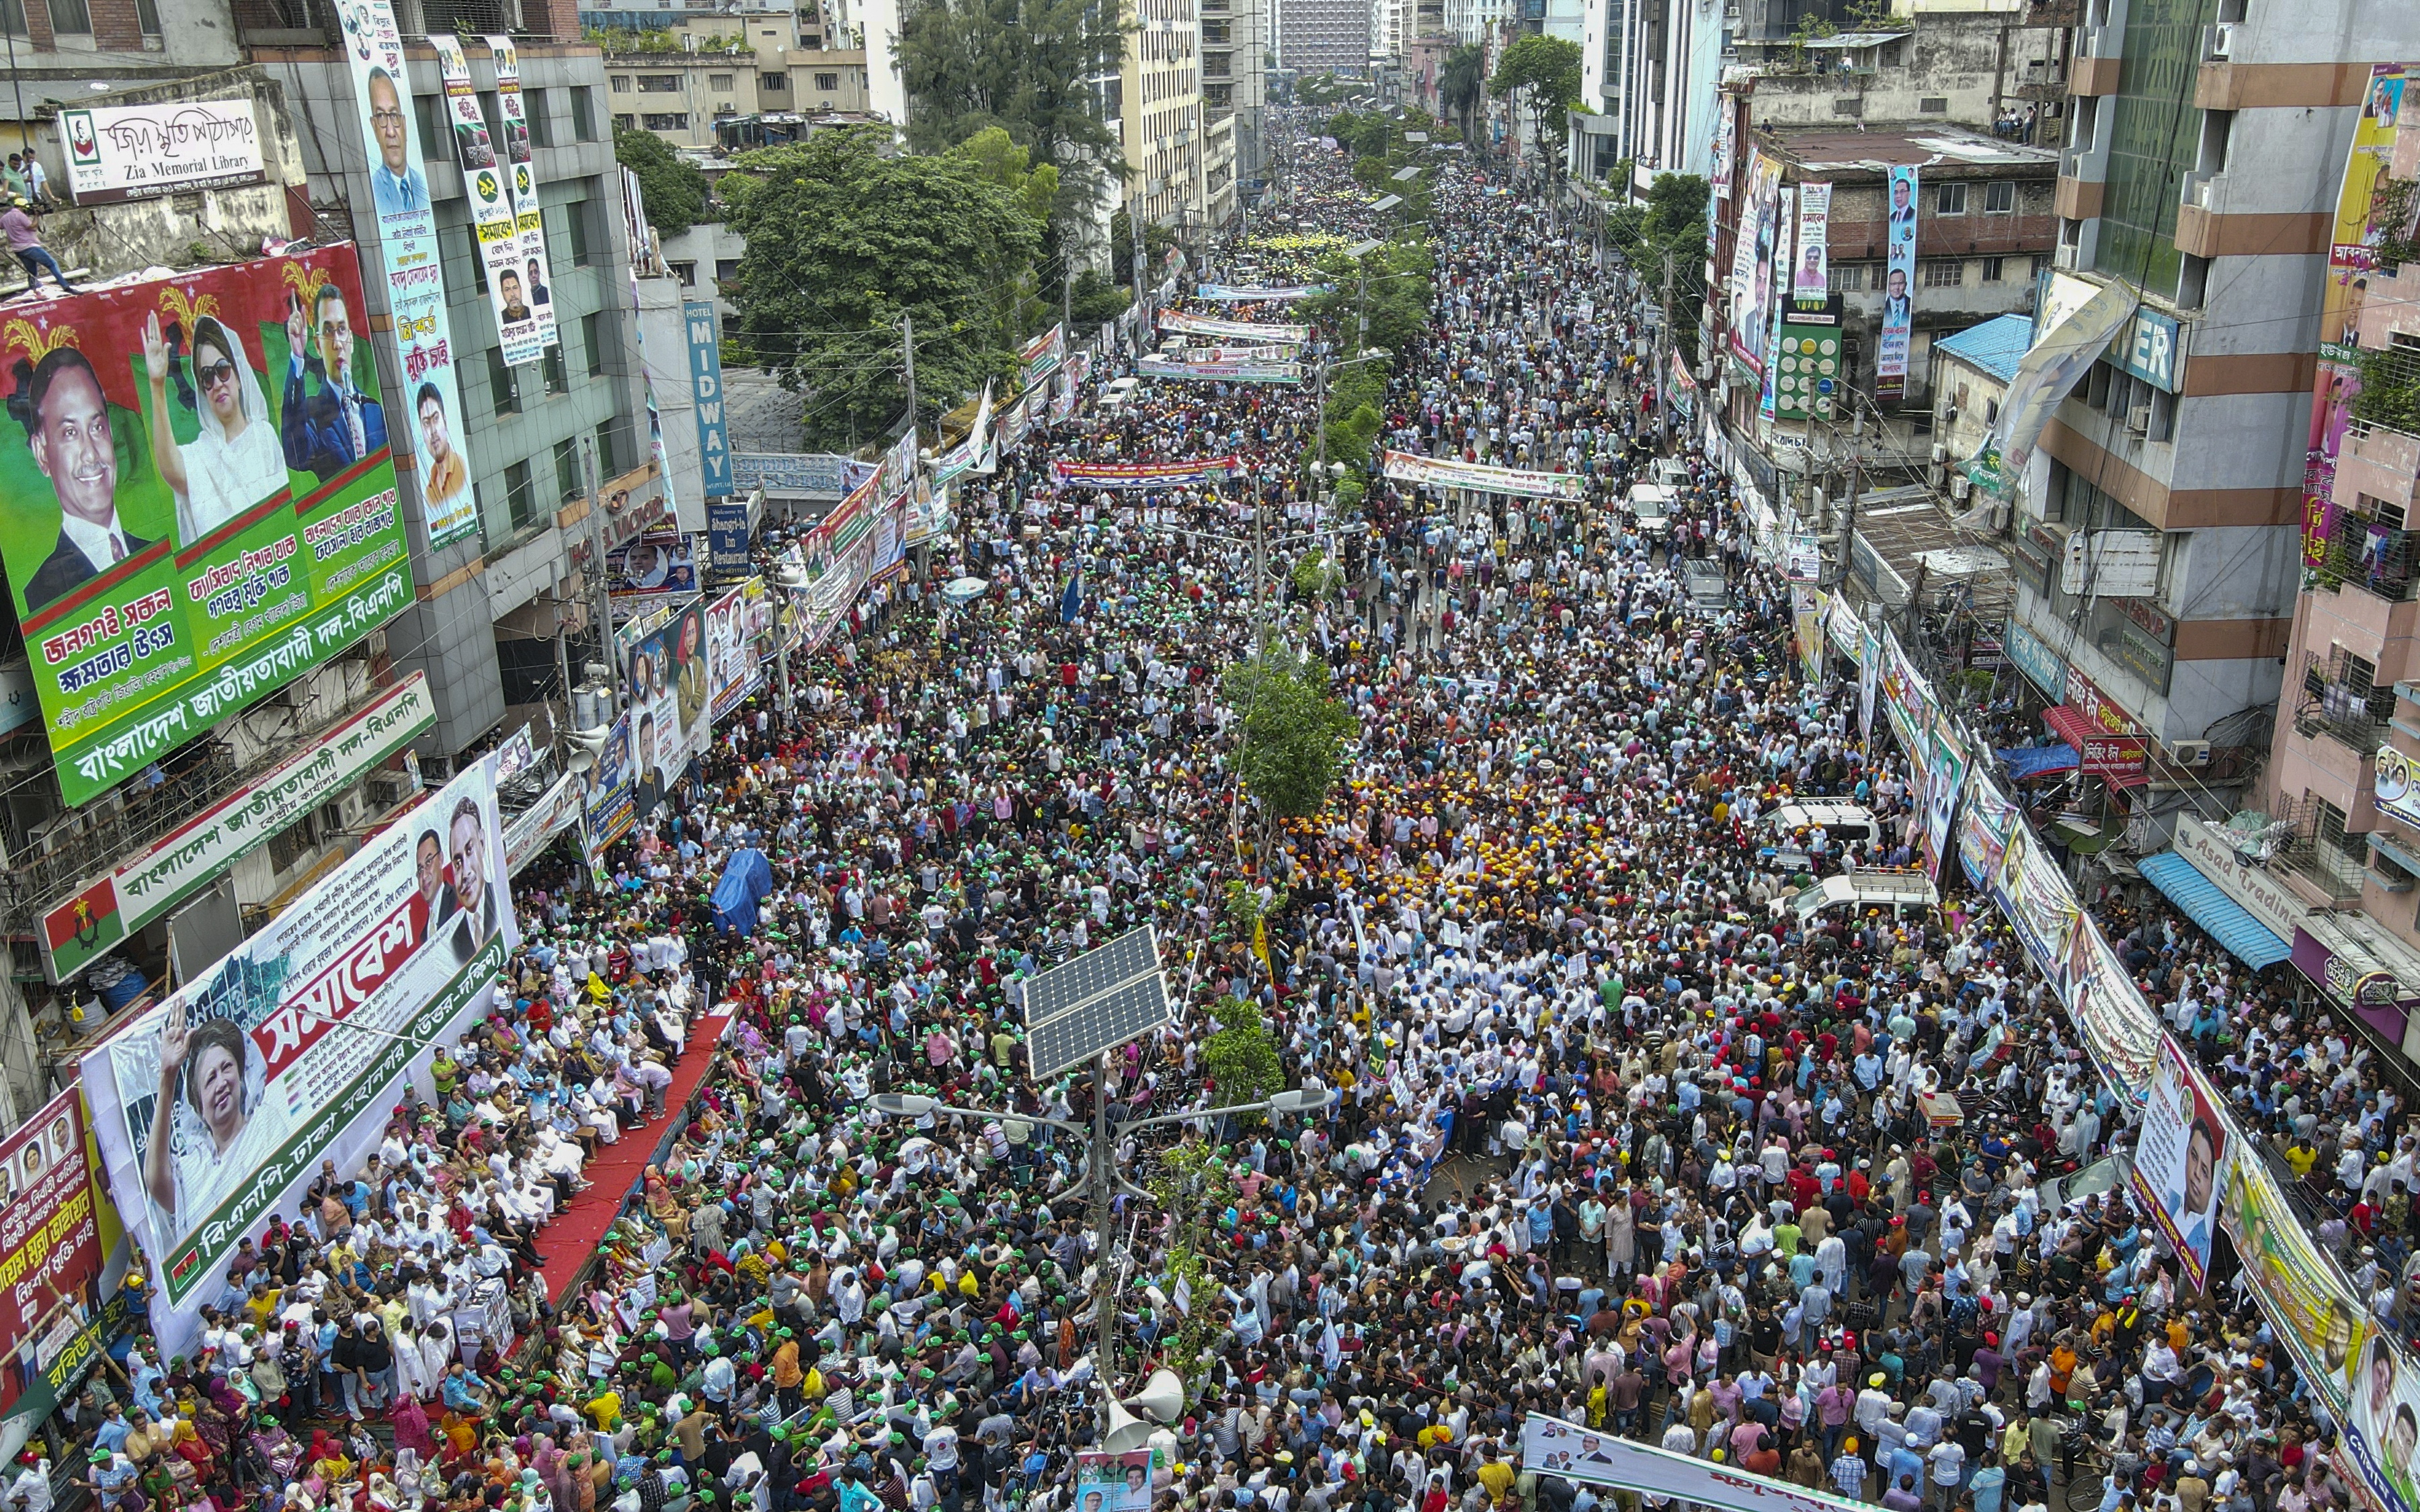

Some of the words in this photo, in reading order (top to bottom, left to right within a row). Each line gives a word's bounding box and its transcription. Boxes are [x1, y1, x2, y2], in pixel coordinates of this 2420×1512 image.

[98, 118, 159, 161] জিয়া
[194, 107, 253, 153] পাঠাগার
[124, 165, 146, 181] Zia
[151, 157, 208, 177] Memorial
[212, 155, 249, 171] Library
[478, 177, 498, 196] ১২
[518, 172, 529, 188] ১২
[479, 220, 514, 241] সমাবেশ
[518, 211, 540, 230] সমাবেশ
[397, 305, 436, 343] নিঃশর্ত
[686, 308, 712, 319] HOTEL
[405, 344, 428, 383] মুক্তি
[428, 337, 449, 369] চাই
[692, 321, 725, 478] MIDWAY
[304, 512, 344, 544] বাংলাদেশ
[343, 503, 362, 526] যাবে
[362, 494, 382, 519] কোন
[381, 487, 397, 507] পথে
[314, 531, 350, 562] ফয়সালা
[349, 524, 364, 544] হবে
[364, 508, 395, 537] রাজপথে
[613, 493, 665, 543] VICTORY
[725, 536, 735, 548] Inn
[188, 560, 241, 601] ফ্যাসিবাদ
[241, 545, 274, 576] নিপাত
[274, 534, 296, 560] যাক
[327, 564, 358, 593] দেশনায়ক
[358, 550, 379, 572] তারেক
[379, 539, 401, 561] রহমান
[713, 550, 748, 565] Restaurant
[208, 585, 243, 618] গণতন্ত্র
[242, 573, 267, 607] মুক্তি
[268, 563, 290, 589] পাক
[2130, 598, 2165, 636] GROUP
[42, 605, 121, 665] জনগণই
[122, 587, 173, 628] সকল
[210, 620, 242, 655] দেশনেত্রী
[243, 614, 264, 636] বেগম
[265, 599, 290, 624] খালেদা
[288, 590, 309, 613] জিয়া
[58, 641, 133, 694] ক্ষমতার
[134, 621, 175, 659] উৎস
[75, 705, 188, 784] বাংলাদেশ
[190, 626, 314, 717] জাতীয়তাবাদী
[315, 572, 404, 647] দল-বিএনপি
[56, 708, 80, 729] শহীদ
[81, 690, 112, 718] রাষ্ট্রপতি
[113, 675, 144, 702] জিয়াউর
[143, 663, 169, 685] রহমান
[2066, 667, 2086, 712] লিভিং
[2085, 742, 2106, 761] লিভিং
[122, 825, 222, 896] বাংলাদেশ
[224, 747, 337, 833] জাতীয়তাবাদী
[337, 692, 421, 757] দল-বিএনপি
[258, 798, 297, 830] কেন্দ্রীয়
[299, 771, 338, 801] কার্যালয়
[122, 847, 153, 872] বাংলাদেশ
[2195, 838, 2234, 877] Asad
[2238, 868, 2299, 934] Trading
[300, 919, 322, 941] সরকারের
[341, 898, 352, 909] এবং
[319, 921, 339, 942] সরকারের
[374, 902, 384, 917] দফা
[261, 903, 414, 1064] সমাবেশ
[200, 1112, 337, 1258] বিএনপি-ঢাকা
[341, 1040, 405, 1114] মহানগর
[411, 943, 502, 1049] (উত্তর-দক্ষিণ)
[2, 1201, 31, 1234] কেন্দ্রীয়
[31, 1175, 55, 1208] নির্বাহী
[56, 1152, 84, 1183] কমিটির
[2, 1220, 26, 1253] বিপ্লবী
[26, 1198, 54, 1231] সাধারণ
[54, 1168, 86, 1206] সম্পাদক
[26, 1226, 50, 1269] মুন্না
[48, 1185, 91, 1244] ভাইয়ের
[15, 1254, 51, 1307] নিঃশর্ত
[51, 1240, 75, 1275] মুক্তি
[75, 1217, 95, 1249] চাই
